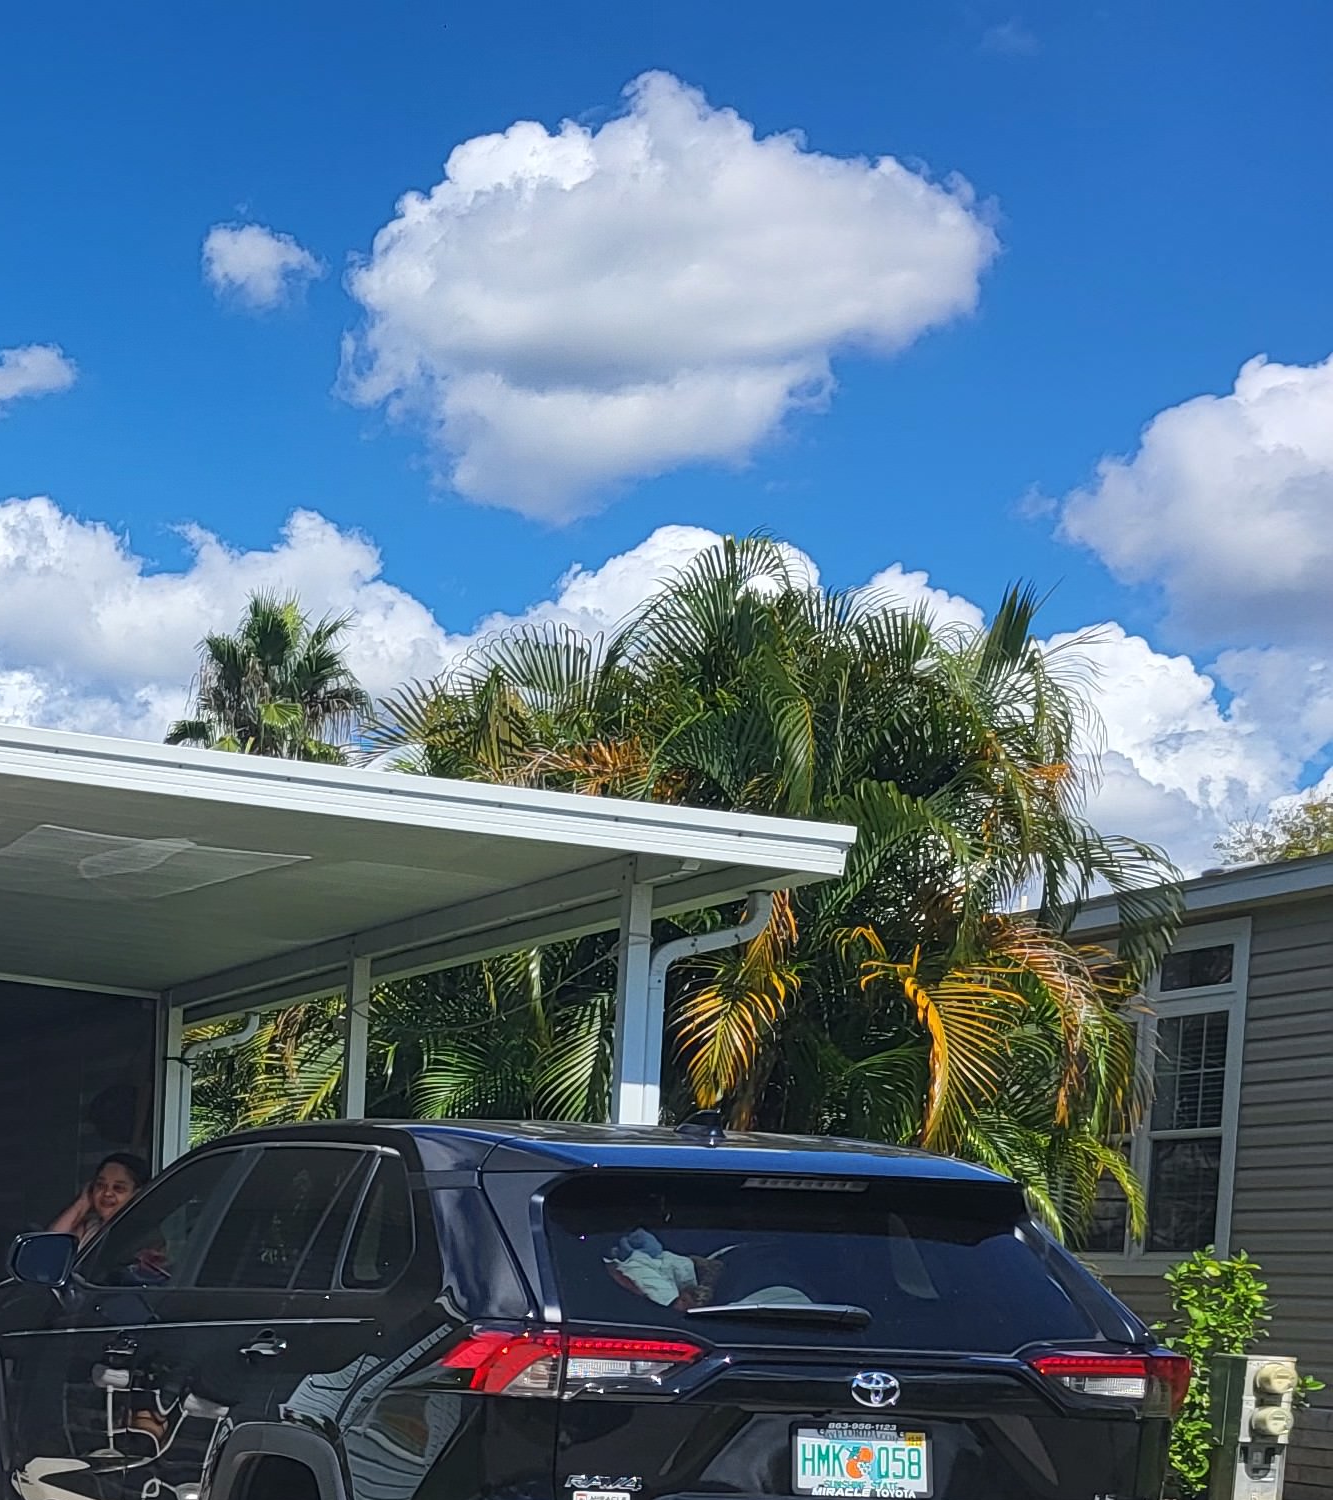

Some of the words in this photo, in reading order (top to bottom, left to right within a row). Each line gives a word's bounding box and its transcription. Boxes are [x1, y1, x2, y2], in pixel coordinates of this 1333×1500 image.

[564, 1474, 643, 1492] RAV4
[811, 1487, 872, 1497] MIRACLE
[876, 1488, 917, 1499] TOYOTA
